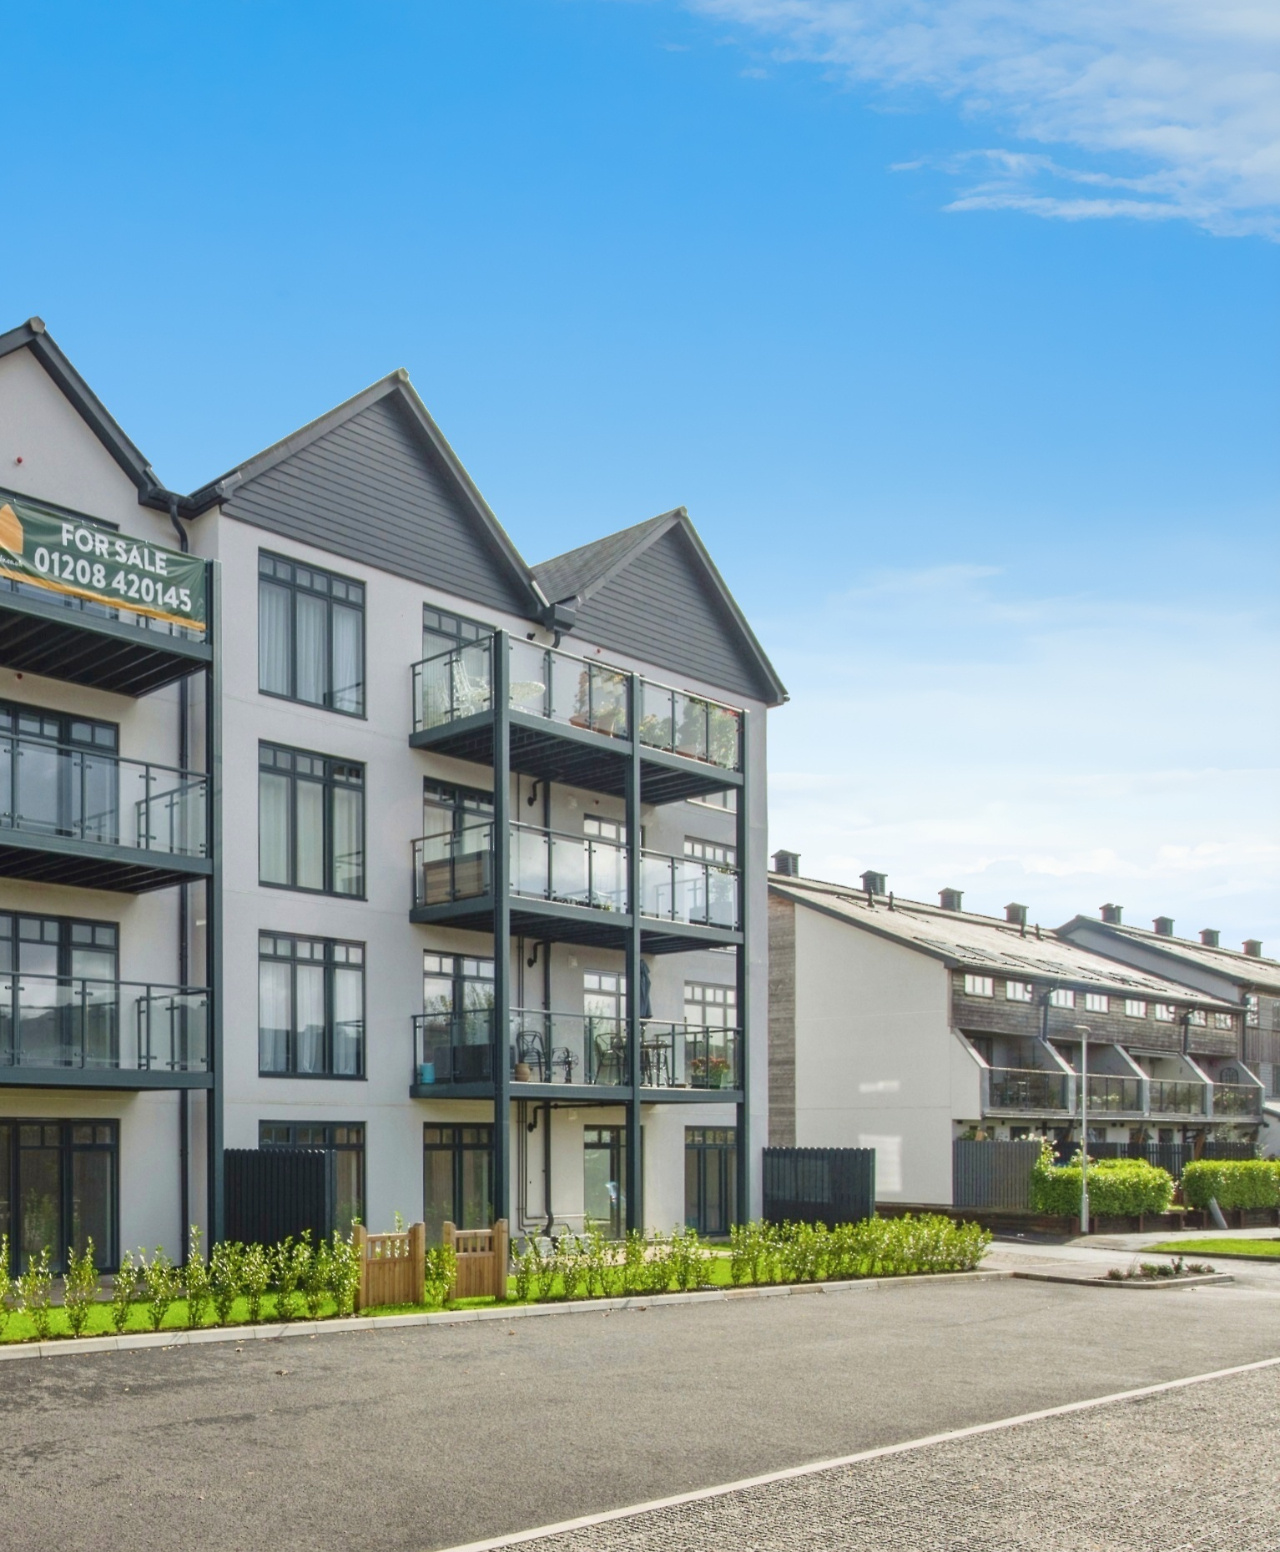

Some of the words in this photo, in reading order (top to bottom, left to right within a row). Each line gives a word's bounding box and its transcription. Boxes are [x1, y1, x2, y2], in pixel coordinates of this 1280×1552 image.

[61, 522, 109, 557] FOR
[115, 540, 168, 576] SALE
[34, 546, 106, 589] 01208
[111, 571, 192, 613] 420145
